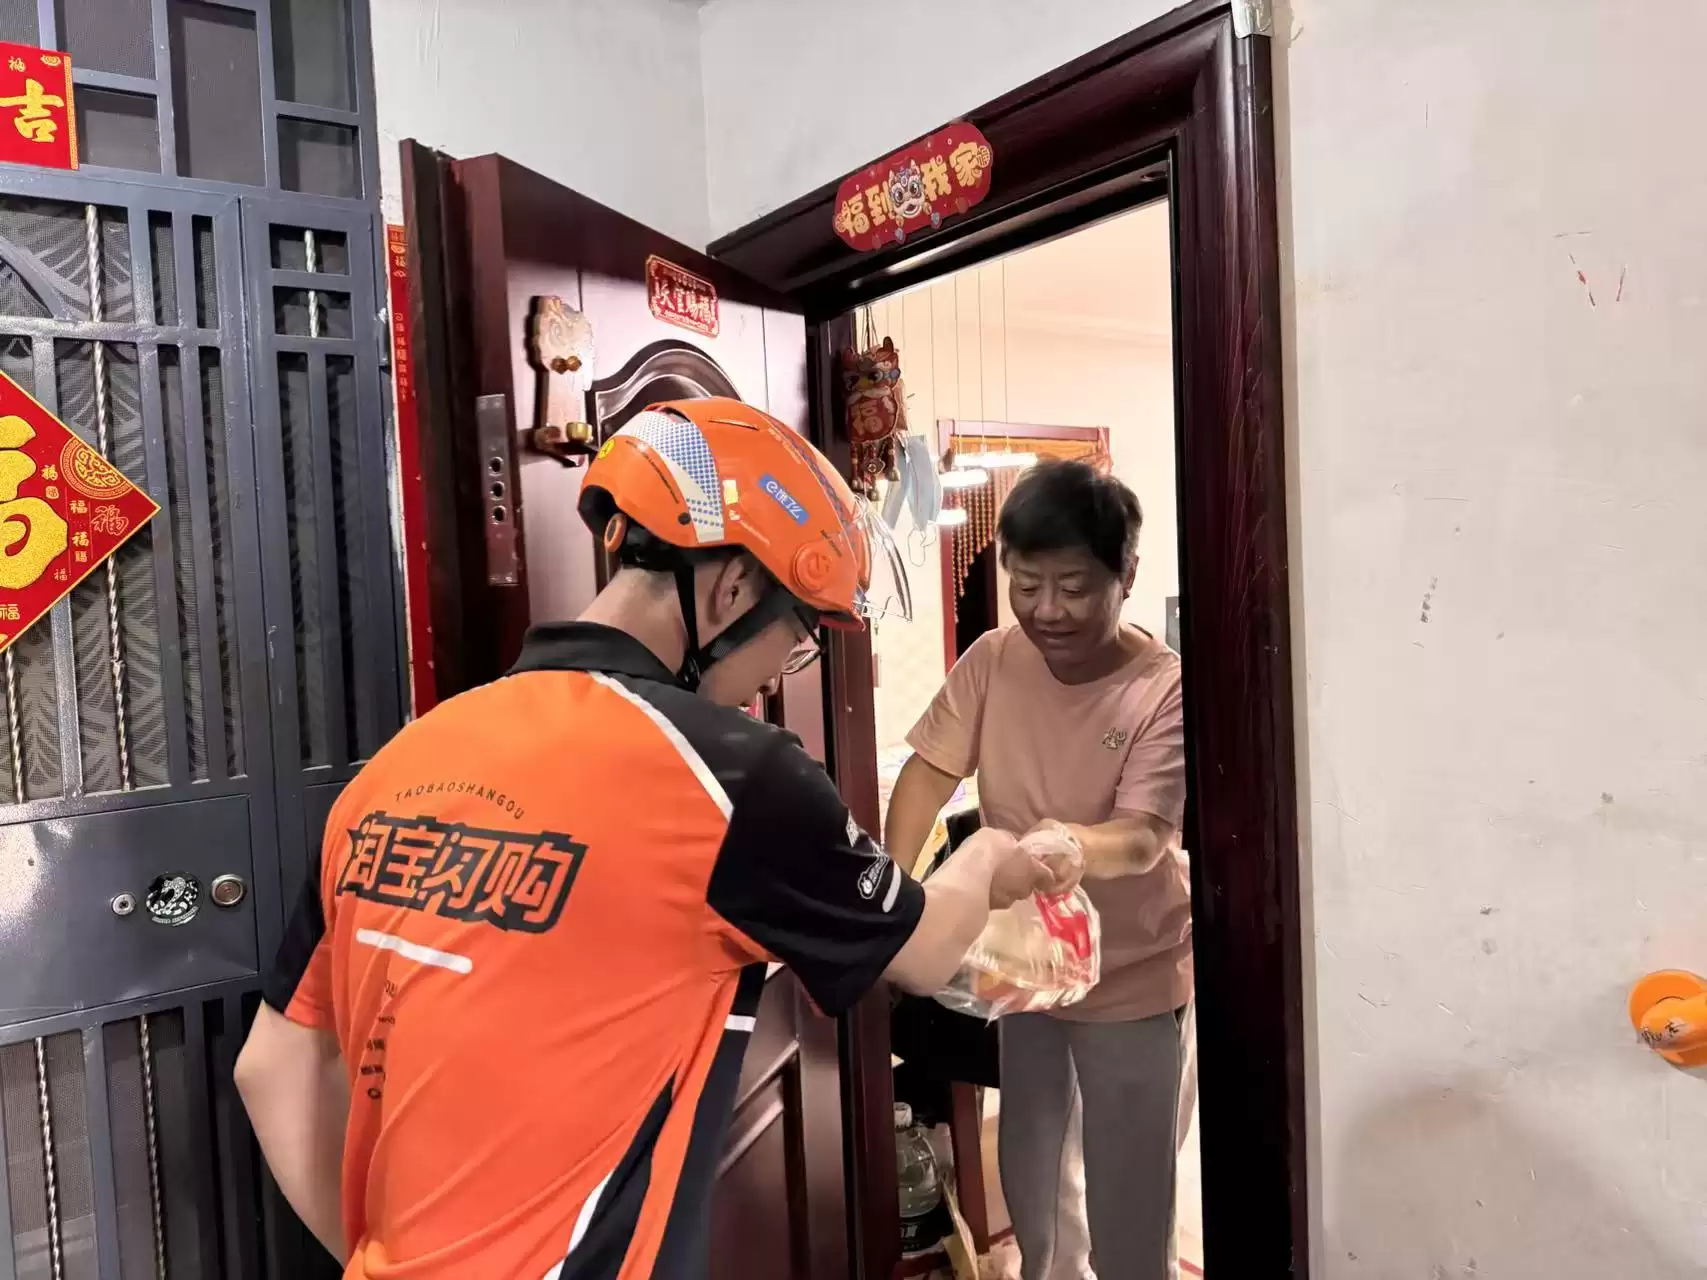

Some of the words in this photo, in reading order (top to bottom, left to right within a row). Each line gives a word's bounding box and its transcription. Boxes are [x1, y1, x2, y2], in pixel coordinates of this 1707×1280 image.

[8, 56, 26, 73] 福
[0, 78, 64, 143] 吉
[840, 141, 983, 239] 福到我家
[850, 401, 884, 437] 福
[42, 464, 58, 480] 福
[70, 500, 88, 513] 福
[72, 531, 89, 547] 福
[395, 781, 526, 820] TAOBAOSHANGOU
[340, 815, 581, 928] 淘宝闪购
